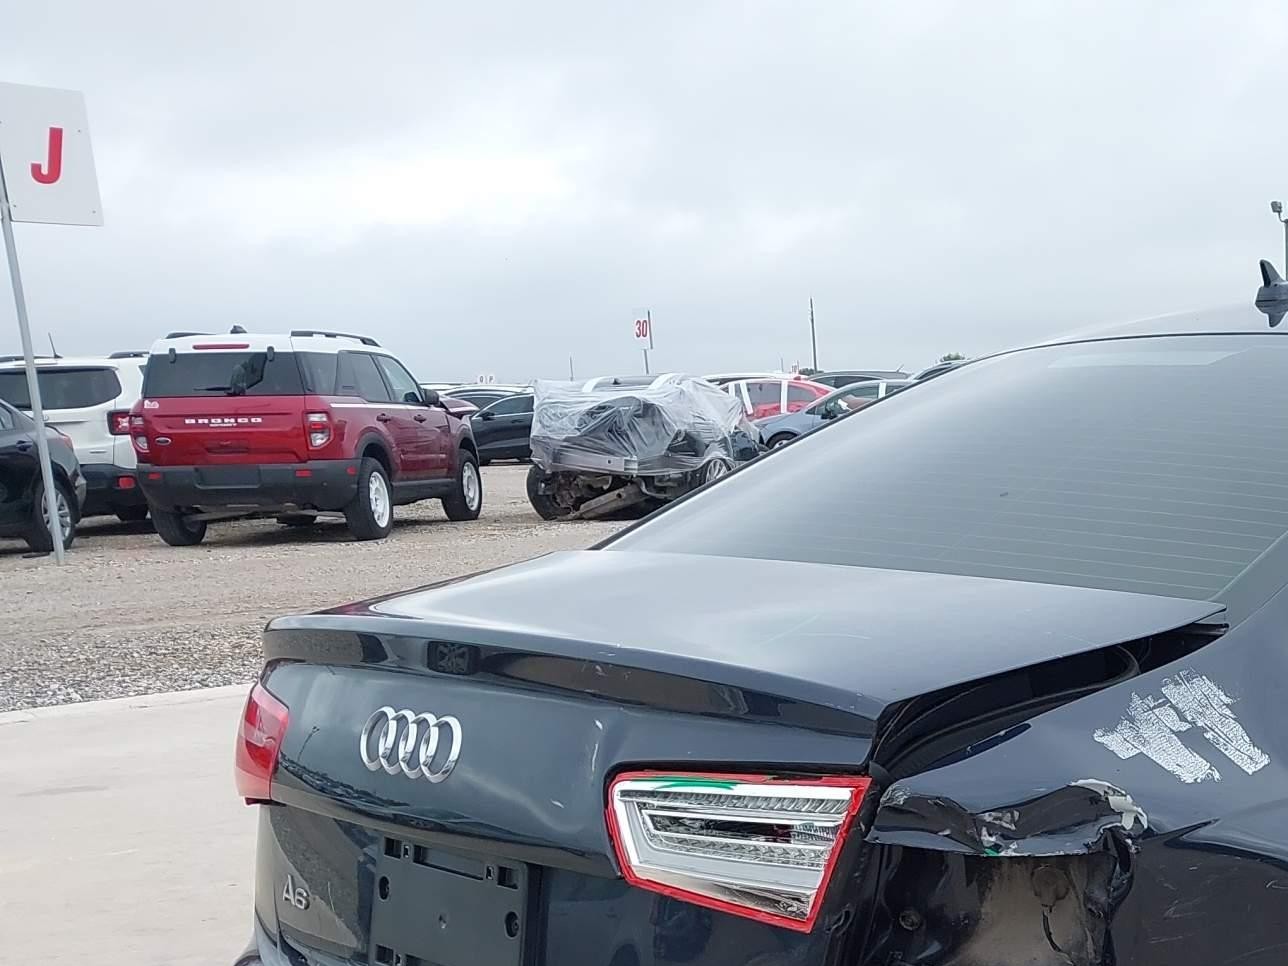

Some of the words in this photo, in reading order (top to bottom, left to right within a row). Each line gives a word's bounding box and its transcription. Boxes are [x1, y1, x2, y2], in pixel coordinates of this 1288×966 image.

[31, 127, 63, 184] J
[635, 319, 648, 338] 30
[184, 416, 263, 424] BRONCO
[282, 873, 310, 910] A6
